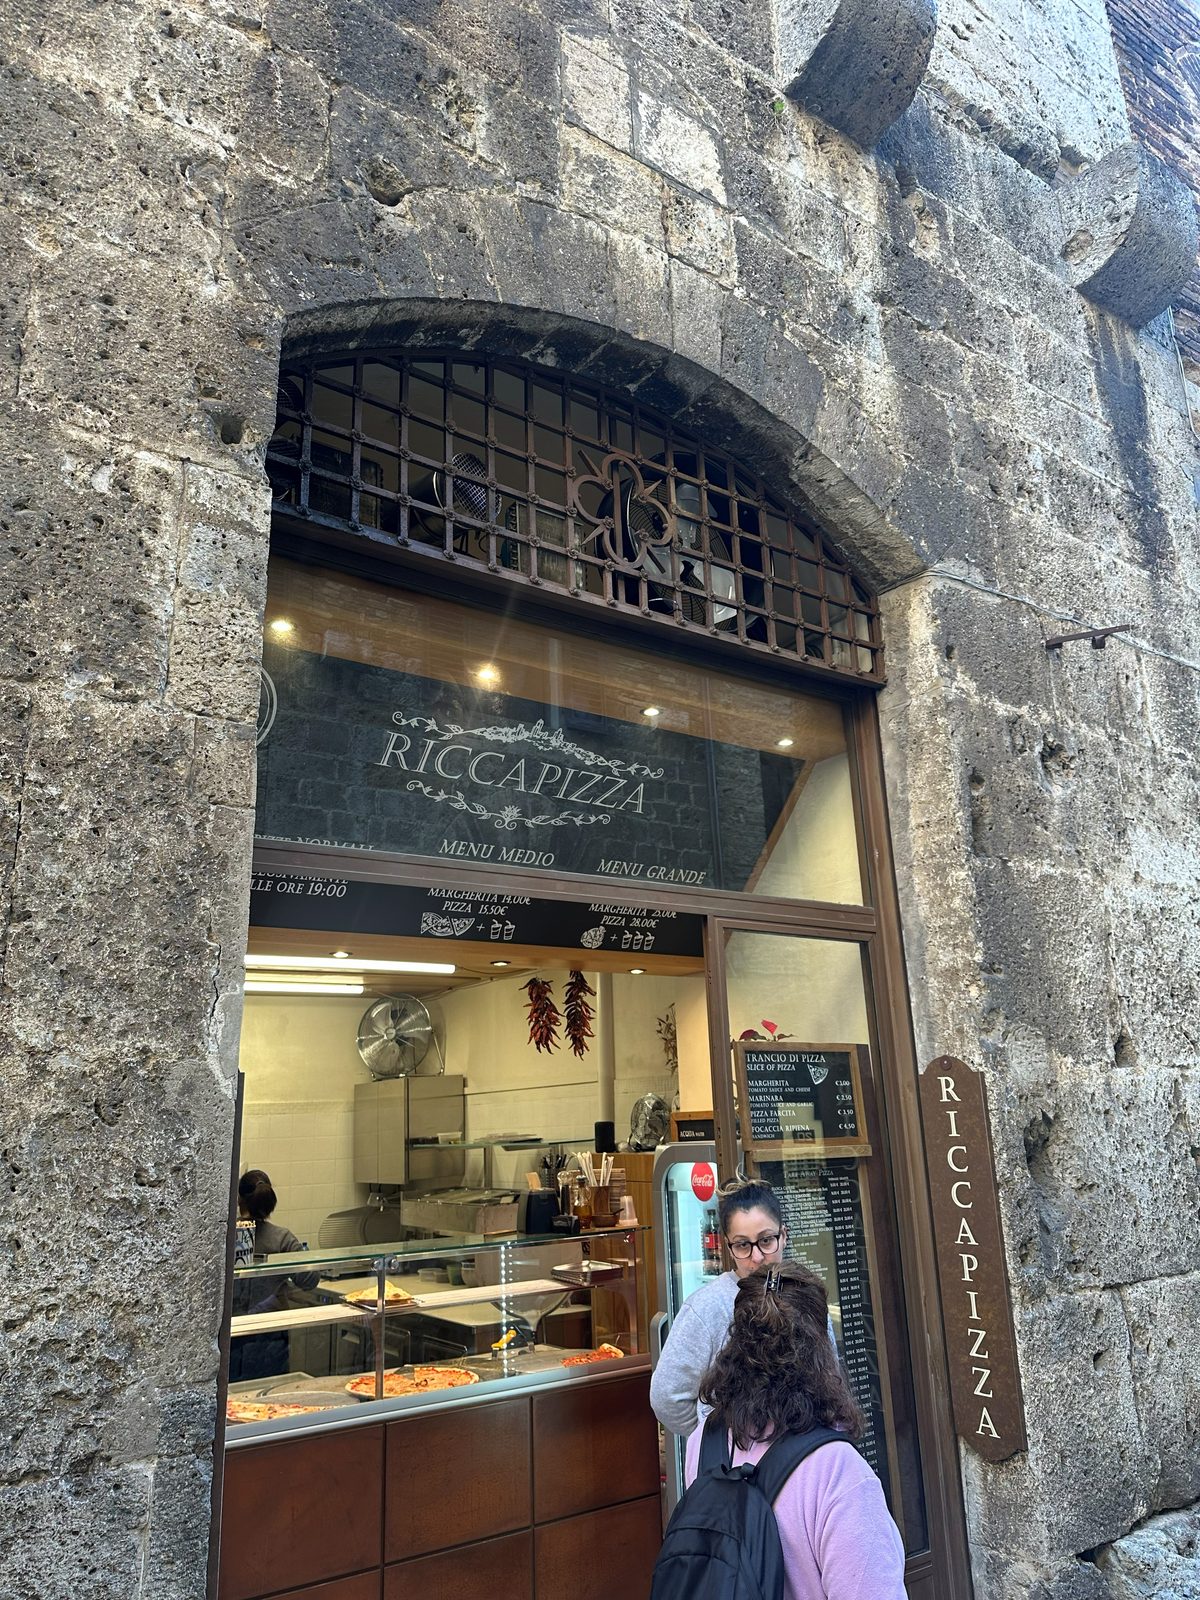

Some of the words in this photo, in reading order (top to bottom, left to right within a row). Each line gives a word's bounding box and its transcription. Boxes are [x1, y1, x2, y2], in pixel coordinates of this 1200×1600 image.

[374, 731, 645, 814] RICCAPIZZA
[438, 839, 495, 859] MENU
[498, 846, 555, 867] MEDIO
[596, 859, 644, 877] MENU
[646, 865, 706, 885] GRANDE
[276, 881, 304, 894] ORE
[306, 882, 347, 897] 19:00
[427, 887, 498, 903] MARGHERITA
[442, 900, 472, 913] PIZZA
[600, 915, 626, 927] PIZZA
[746, 1053, 787, 1062] TRANCIO
[789, 1054, 799, 1062] DI
[801, 1054, 826, 1063] PIZZA
[746, 1063, 764, 1071] SLICE
[937, 1076, 1001, 1439] RICCAPIZZA
